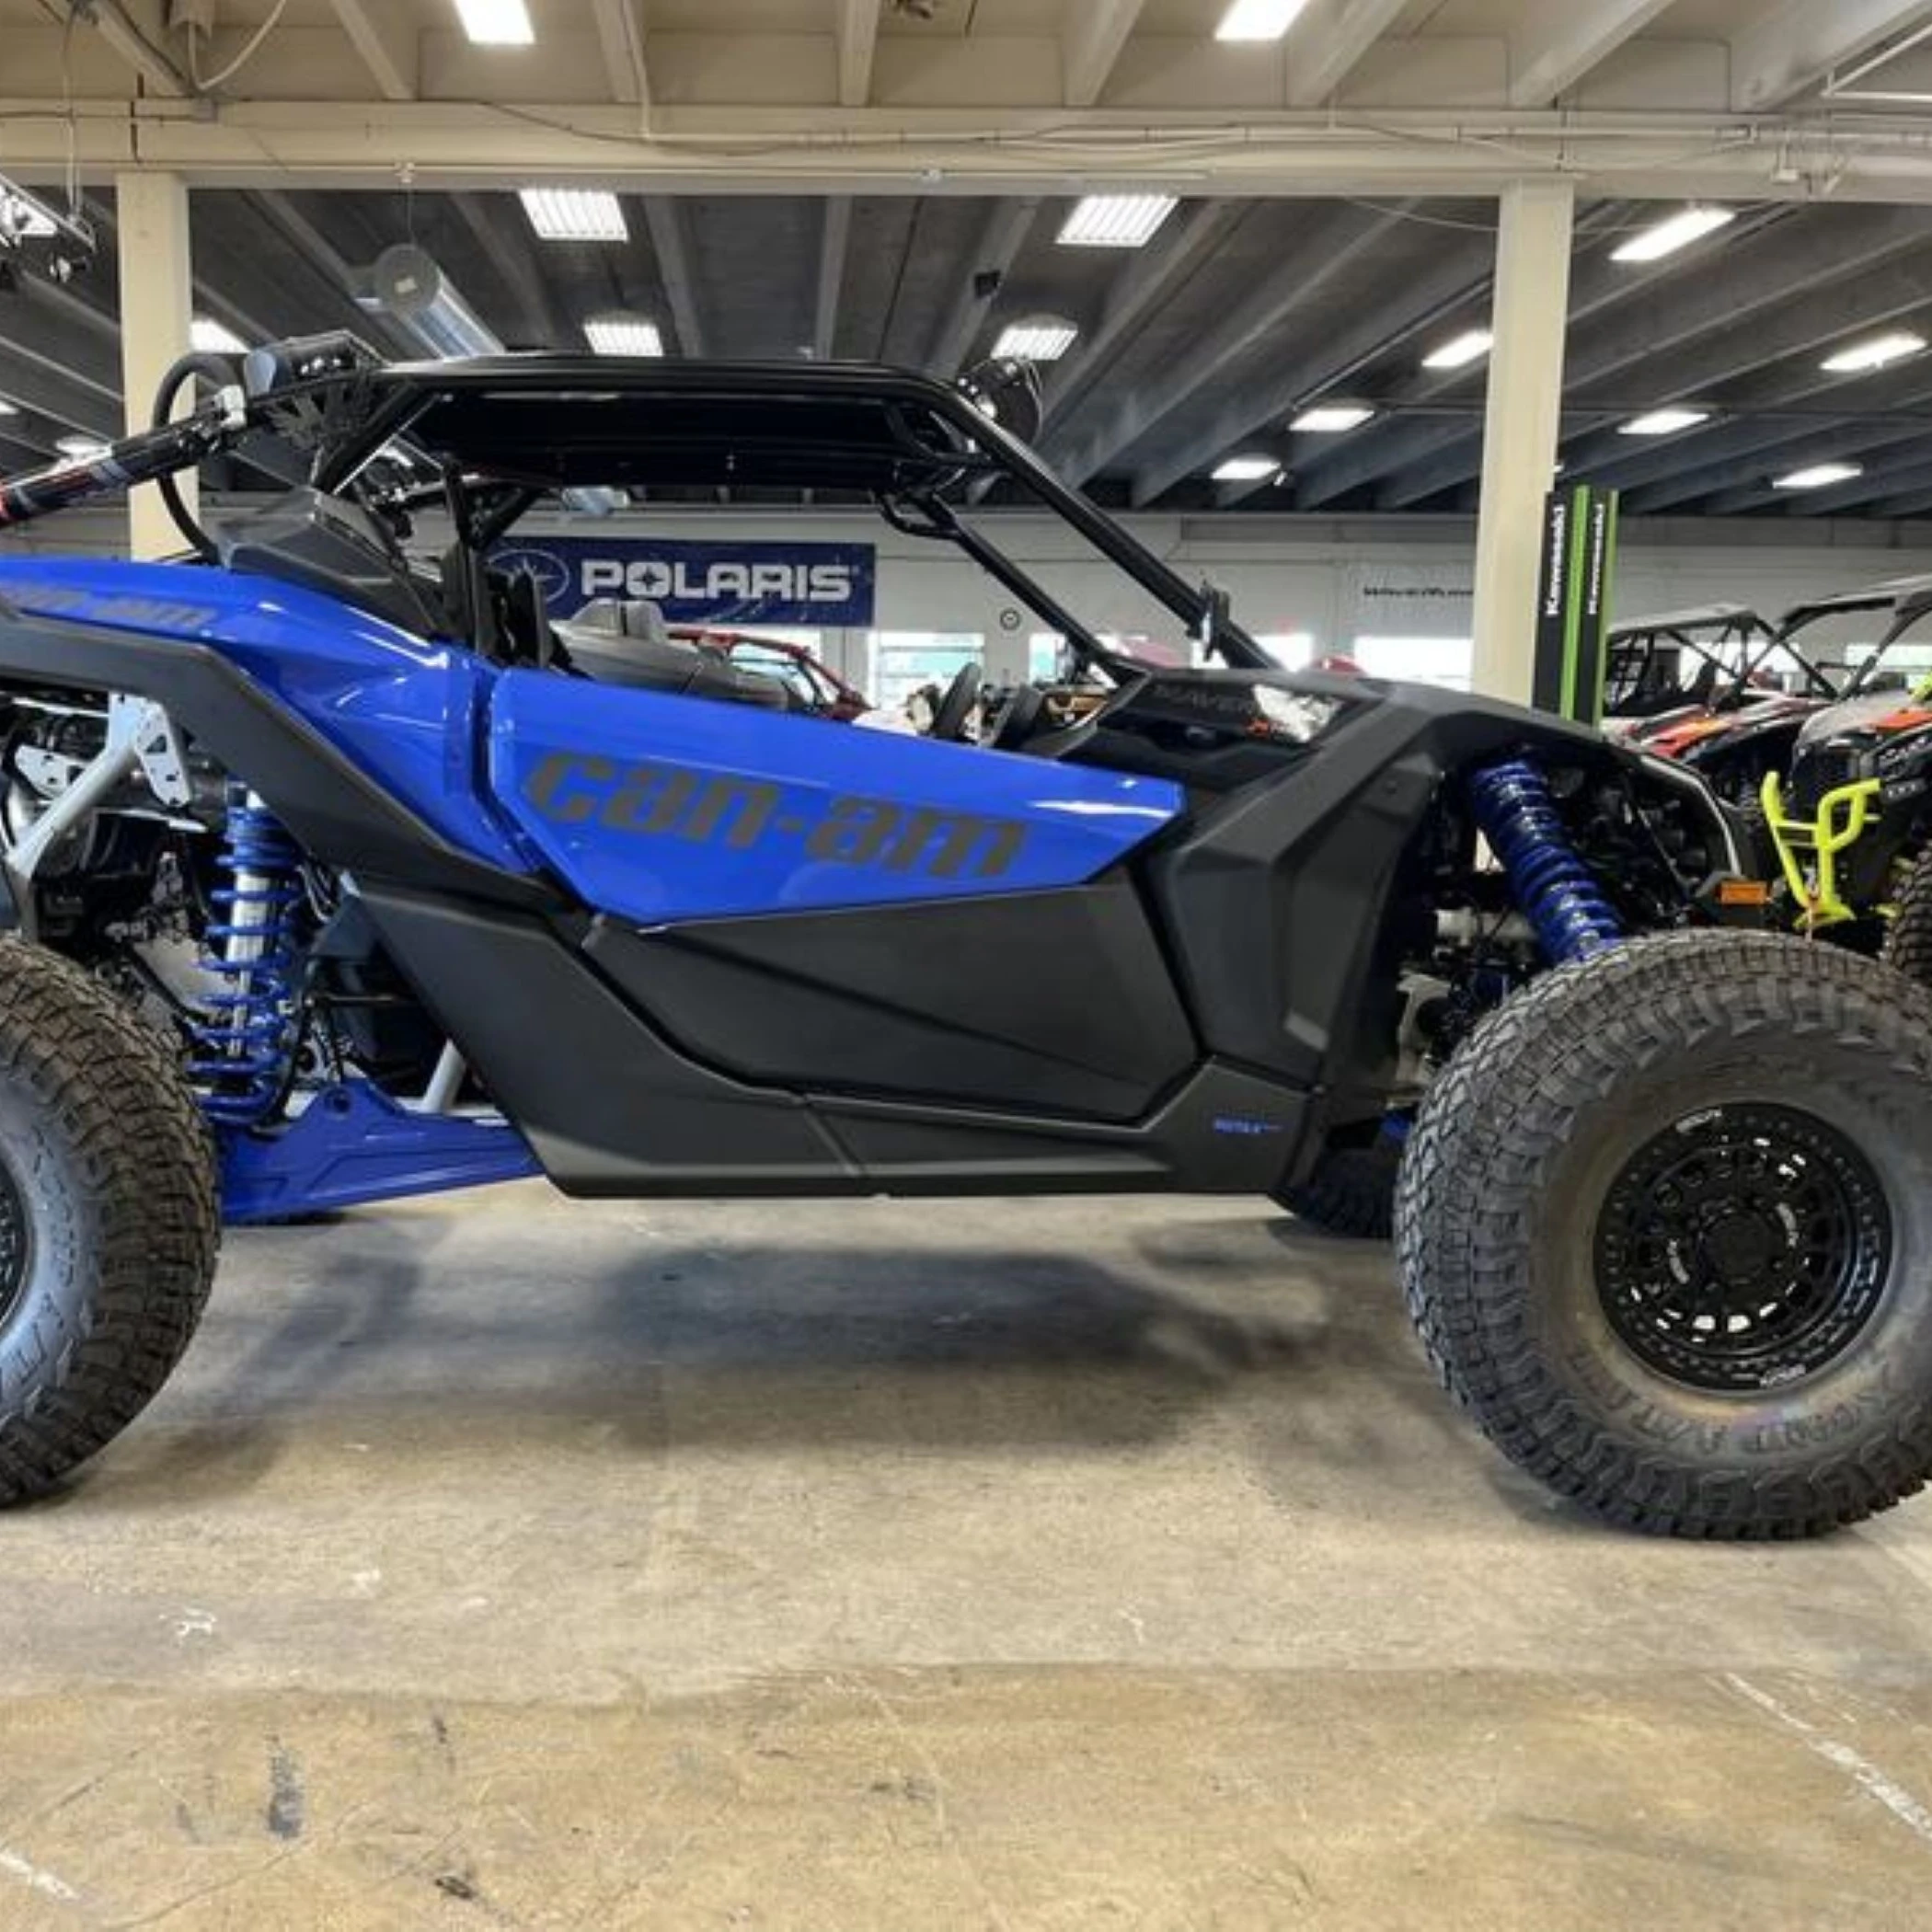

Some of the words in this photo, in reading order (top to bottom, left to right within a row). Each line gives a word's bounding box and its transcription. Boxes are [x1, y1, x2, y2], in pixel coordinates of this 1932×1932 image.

[581, 559, 851, 603] POLARIS
[1546, 503, 1566, 615] Kawasaki
[522, 752, 1027, 878] can-am
